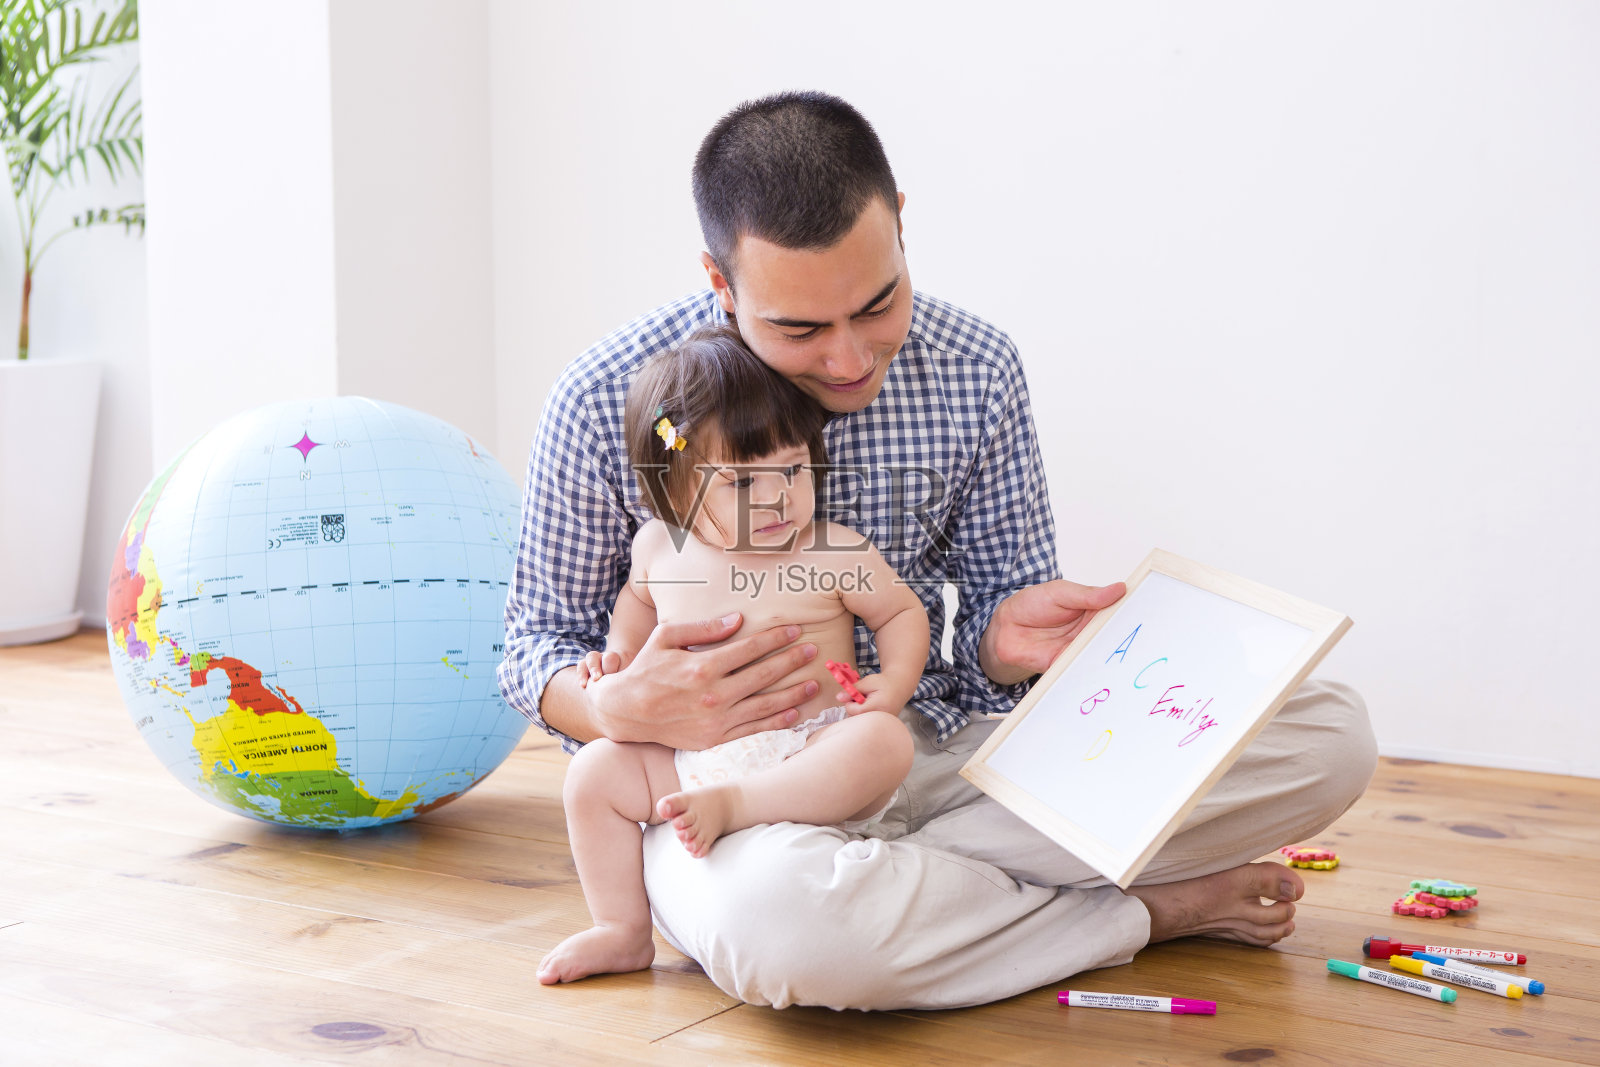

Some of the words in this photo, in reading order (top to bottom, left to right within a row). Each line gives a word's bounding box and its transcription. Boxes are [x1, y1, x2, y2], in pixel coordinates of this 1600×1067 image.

[299, 470, 311, 481] N
[321, 515, 344, 523] CALY
[1105, 623, 1142, 664] A
[1133, 657, 1168, 689] C
[226, 682, 250, 690] MEXICO
[1080, 688, 1110, 715] B
[1148, 684, 1219, 747] Emily
[268, 732, 291, 742] STATES
[292, 729, 316, 739] UNITED
[233, 738, 258, 746] AMERICA
[1083, 729, 1112, 761] D
[243, 747, 288, 760] AMERICA
[292, 743, 328, 754] NORTH
[299, 789, 338, 797] CANADA
